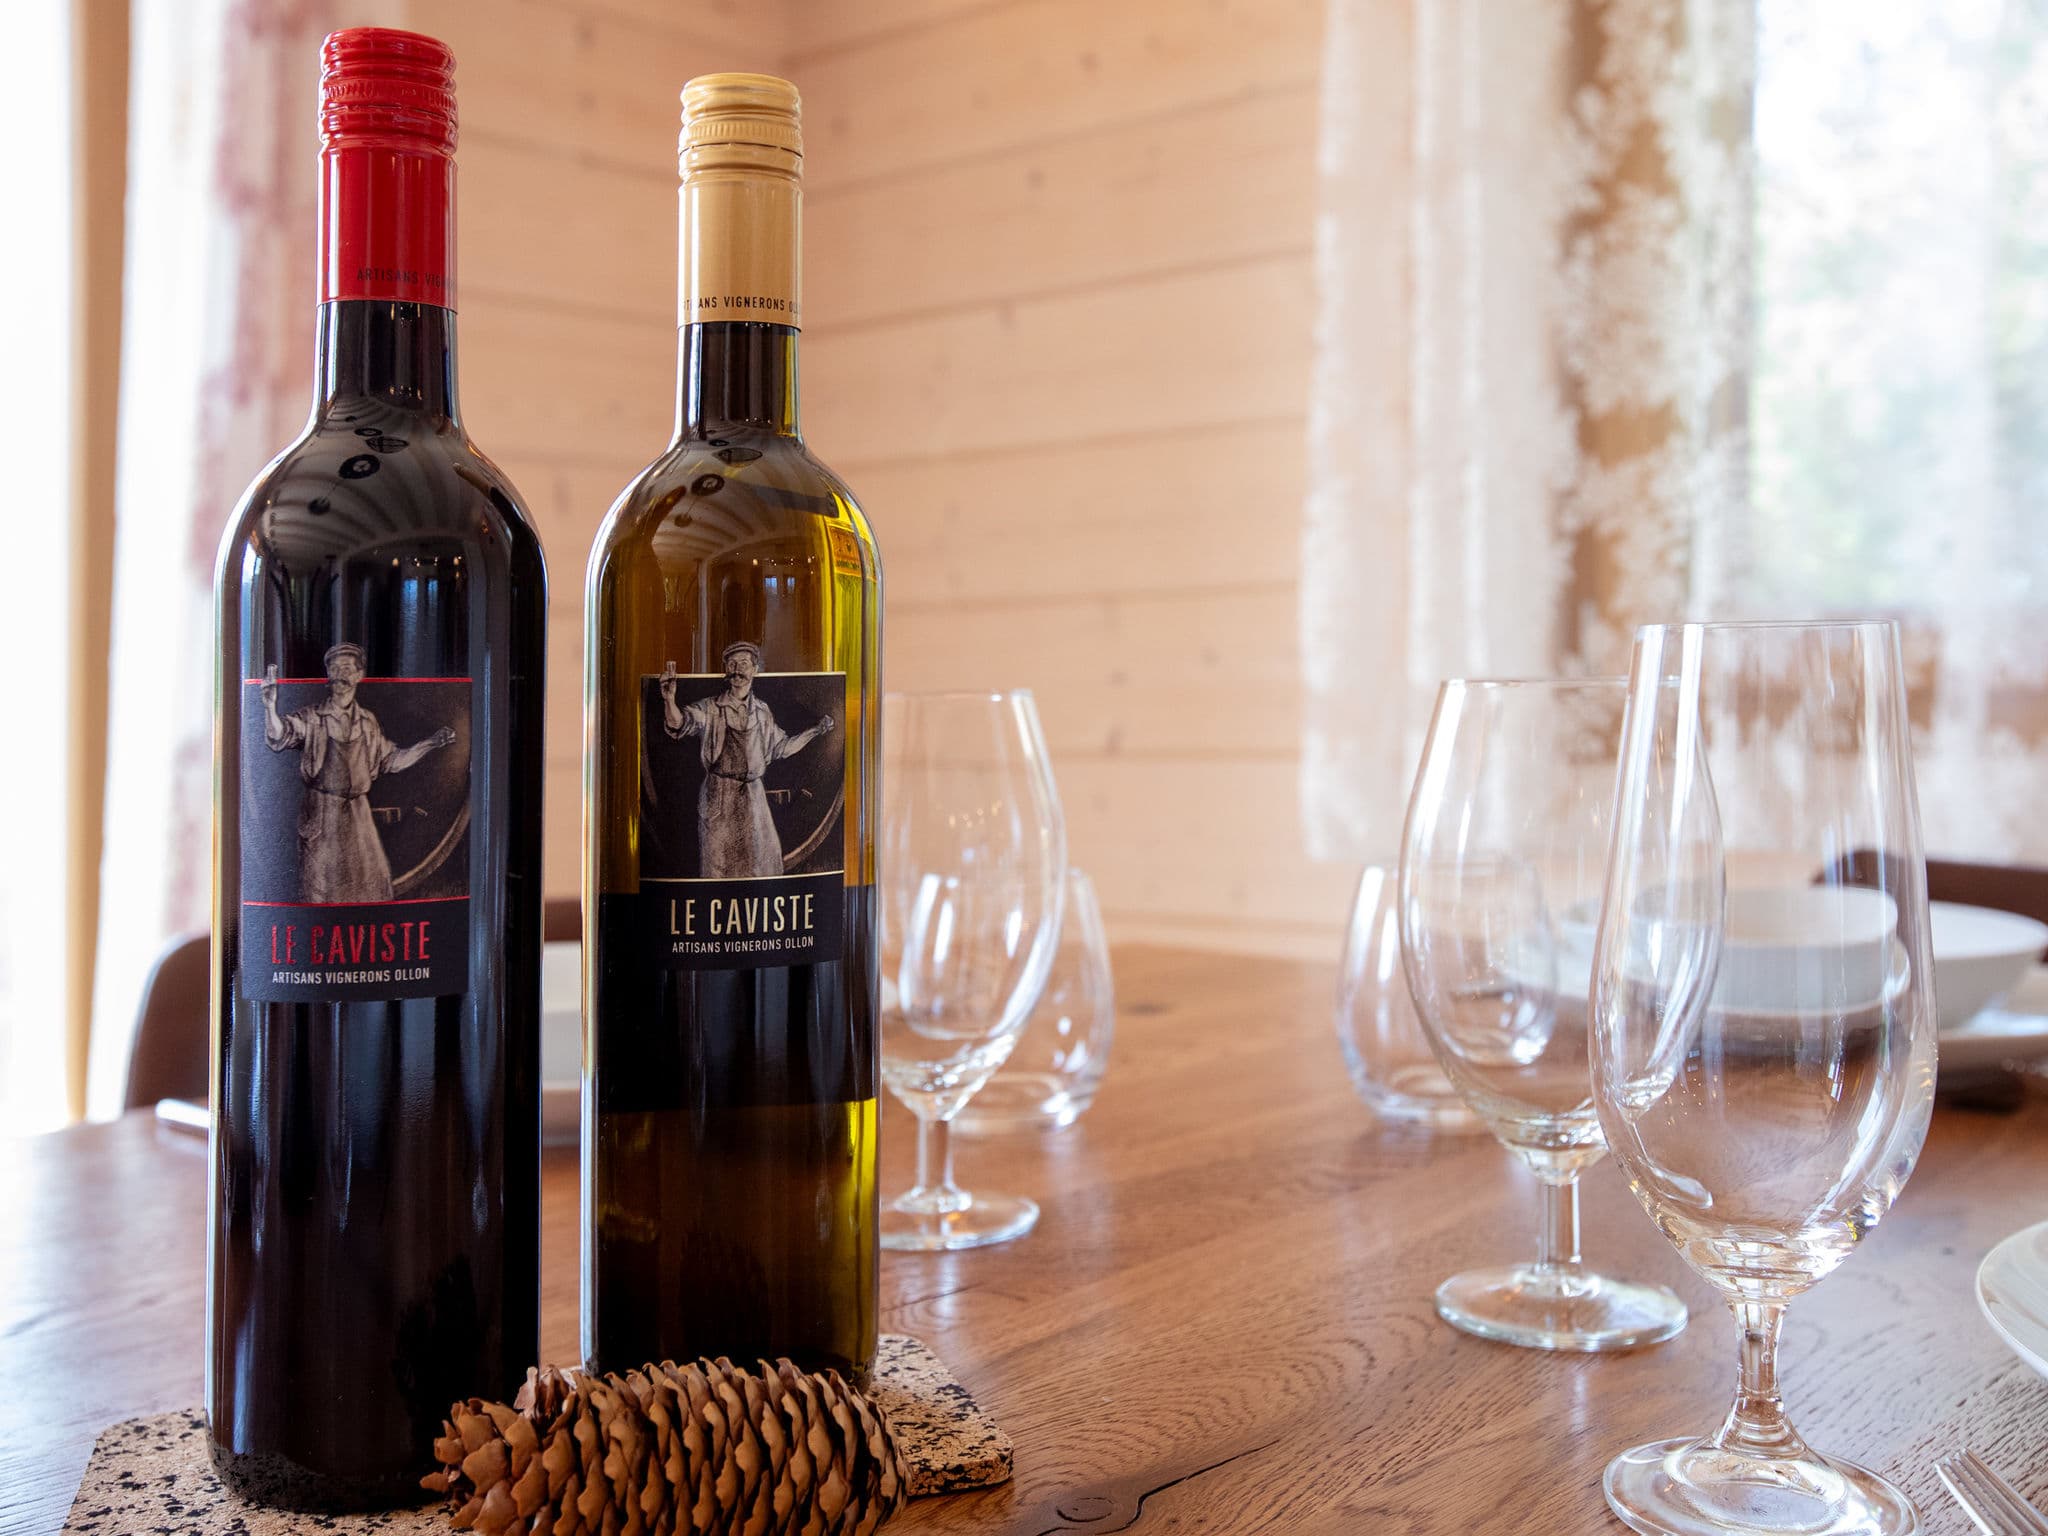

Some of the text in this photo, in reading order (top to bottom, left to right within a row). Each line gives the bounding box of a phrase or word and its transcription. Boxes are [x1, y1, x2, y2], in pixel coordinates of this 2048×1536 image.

[357, 266, 419, 285] ARTISANS
[723, 295, 785, 311] VIGNERONS
[671, 893, 814, 935] LE CAVISTE
[271, 920, 431, 966] LE CAVISTE
[672, 935, 814, 954] ARTISANS VIGNERONS OLLON
[272, 967, 430, 985] ARTISANS VIGNERONS OLLON
